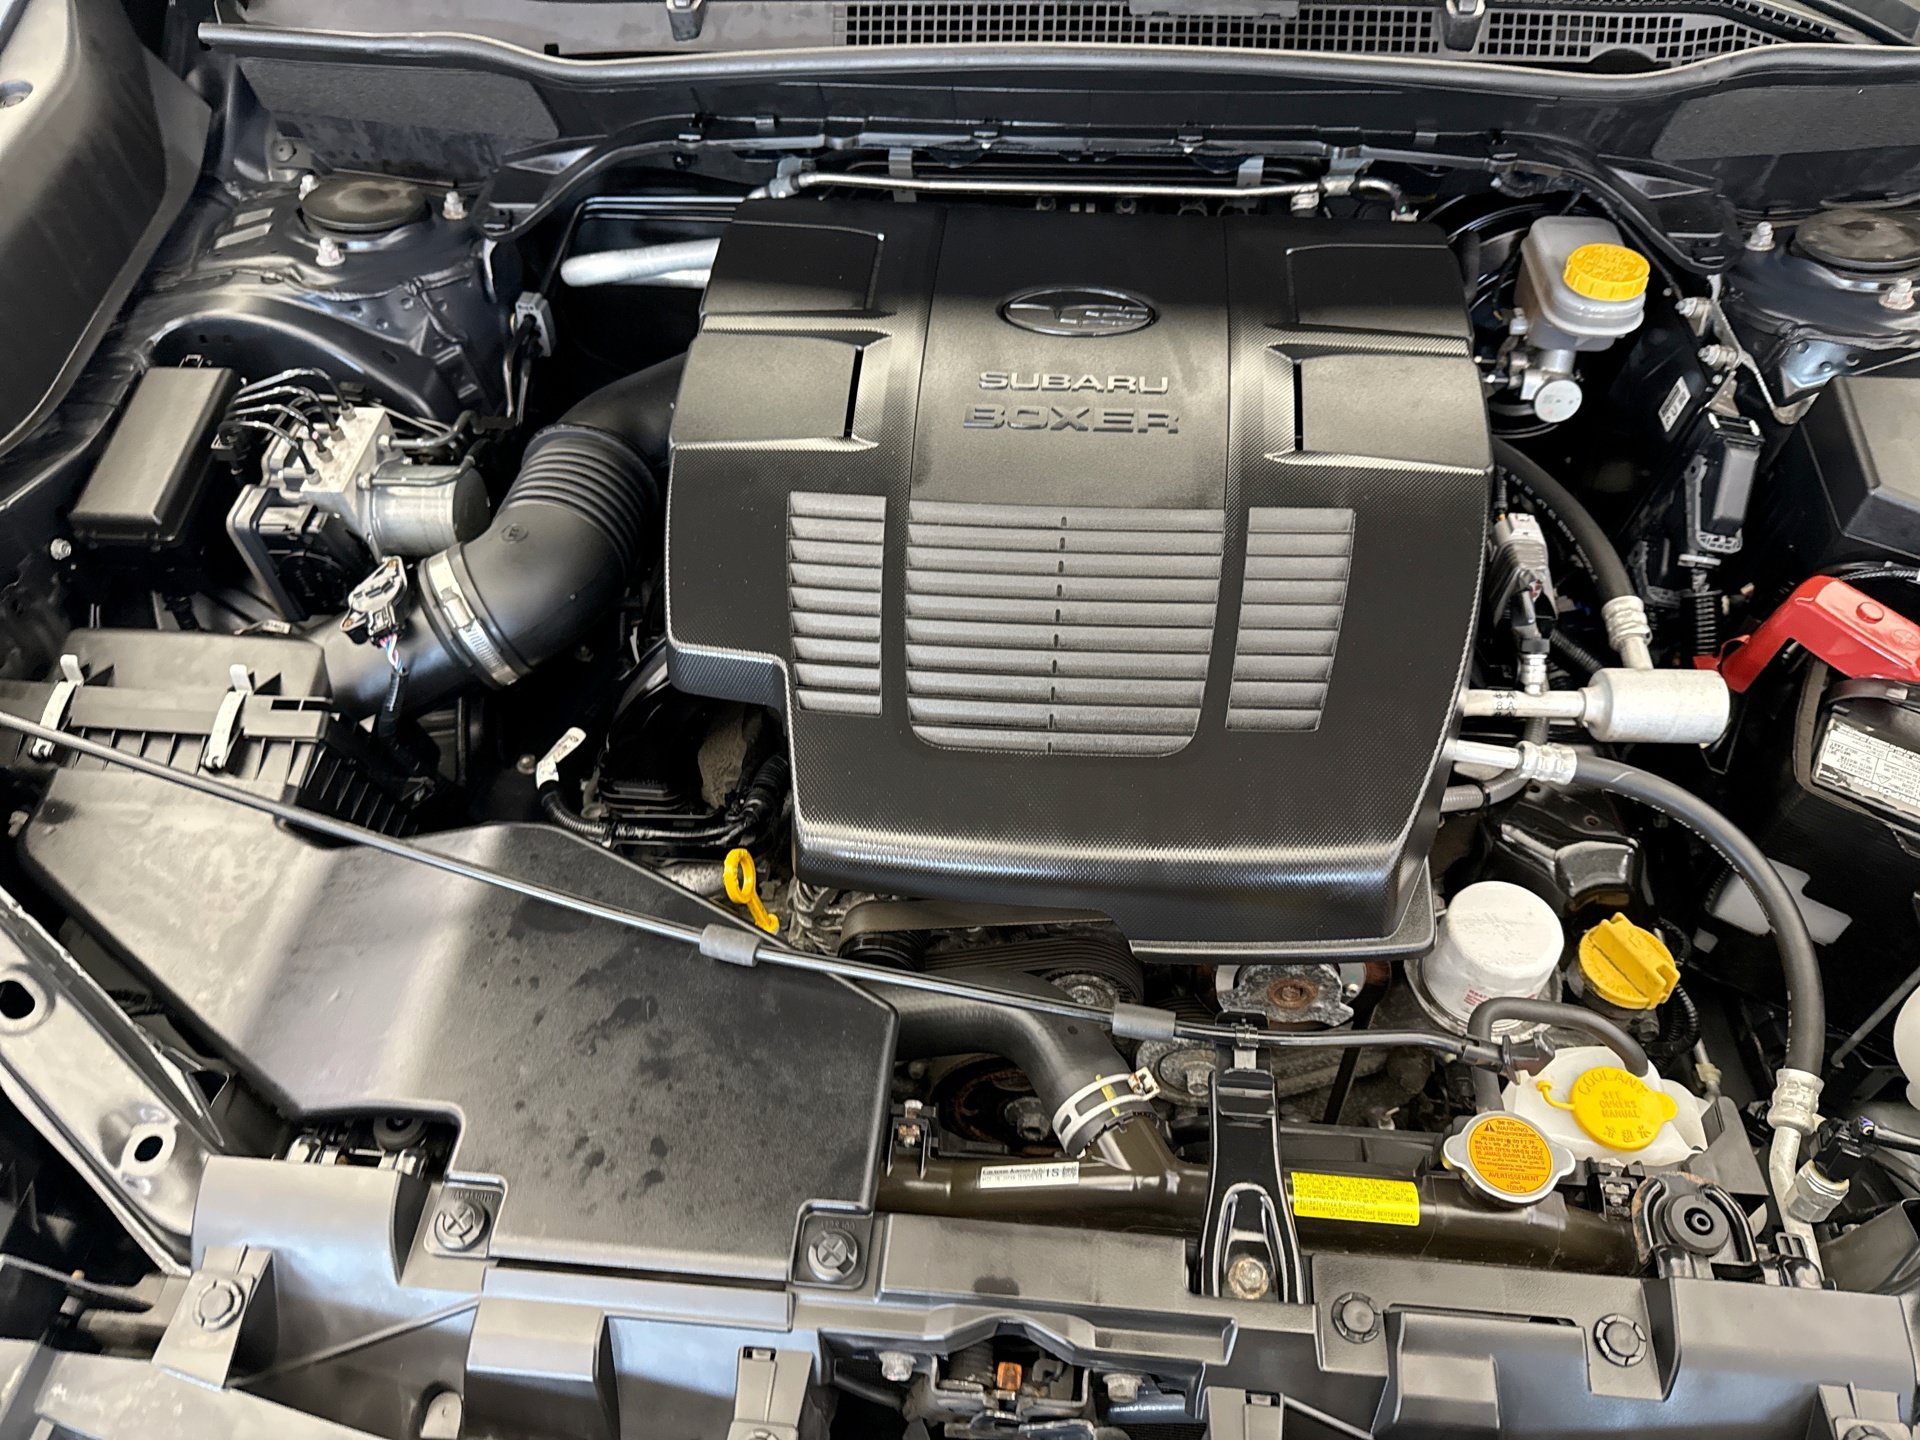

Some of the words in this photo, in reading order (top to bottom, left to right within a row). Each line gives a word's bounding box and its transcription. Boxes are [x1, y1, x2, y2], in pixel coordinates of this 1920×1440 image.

[979, 371, 1169, 395] SUBARU
[963, 403, 1179, 434] BOXER
[1577, 1069, 1649, 1096] COOLANT
[1601, 1109, 1640, 1118] MANUAL
[1496, 1125, 1528, 1133] WARNING
[1489, 1171, 1539, 1182] AVERTISSEMENT
